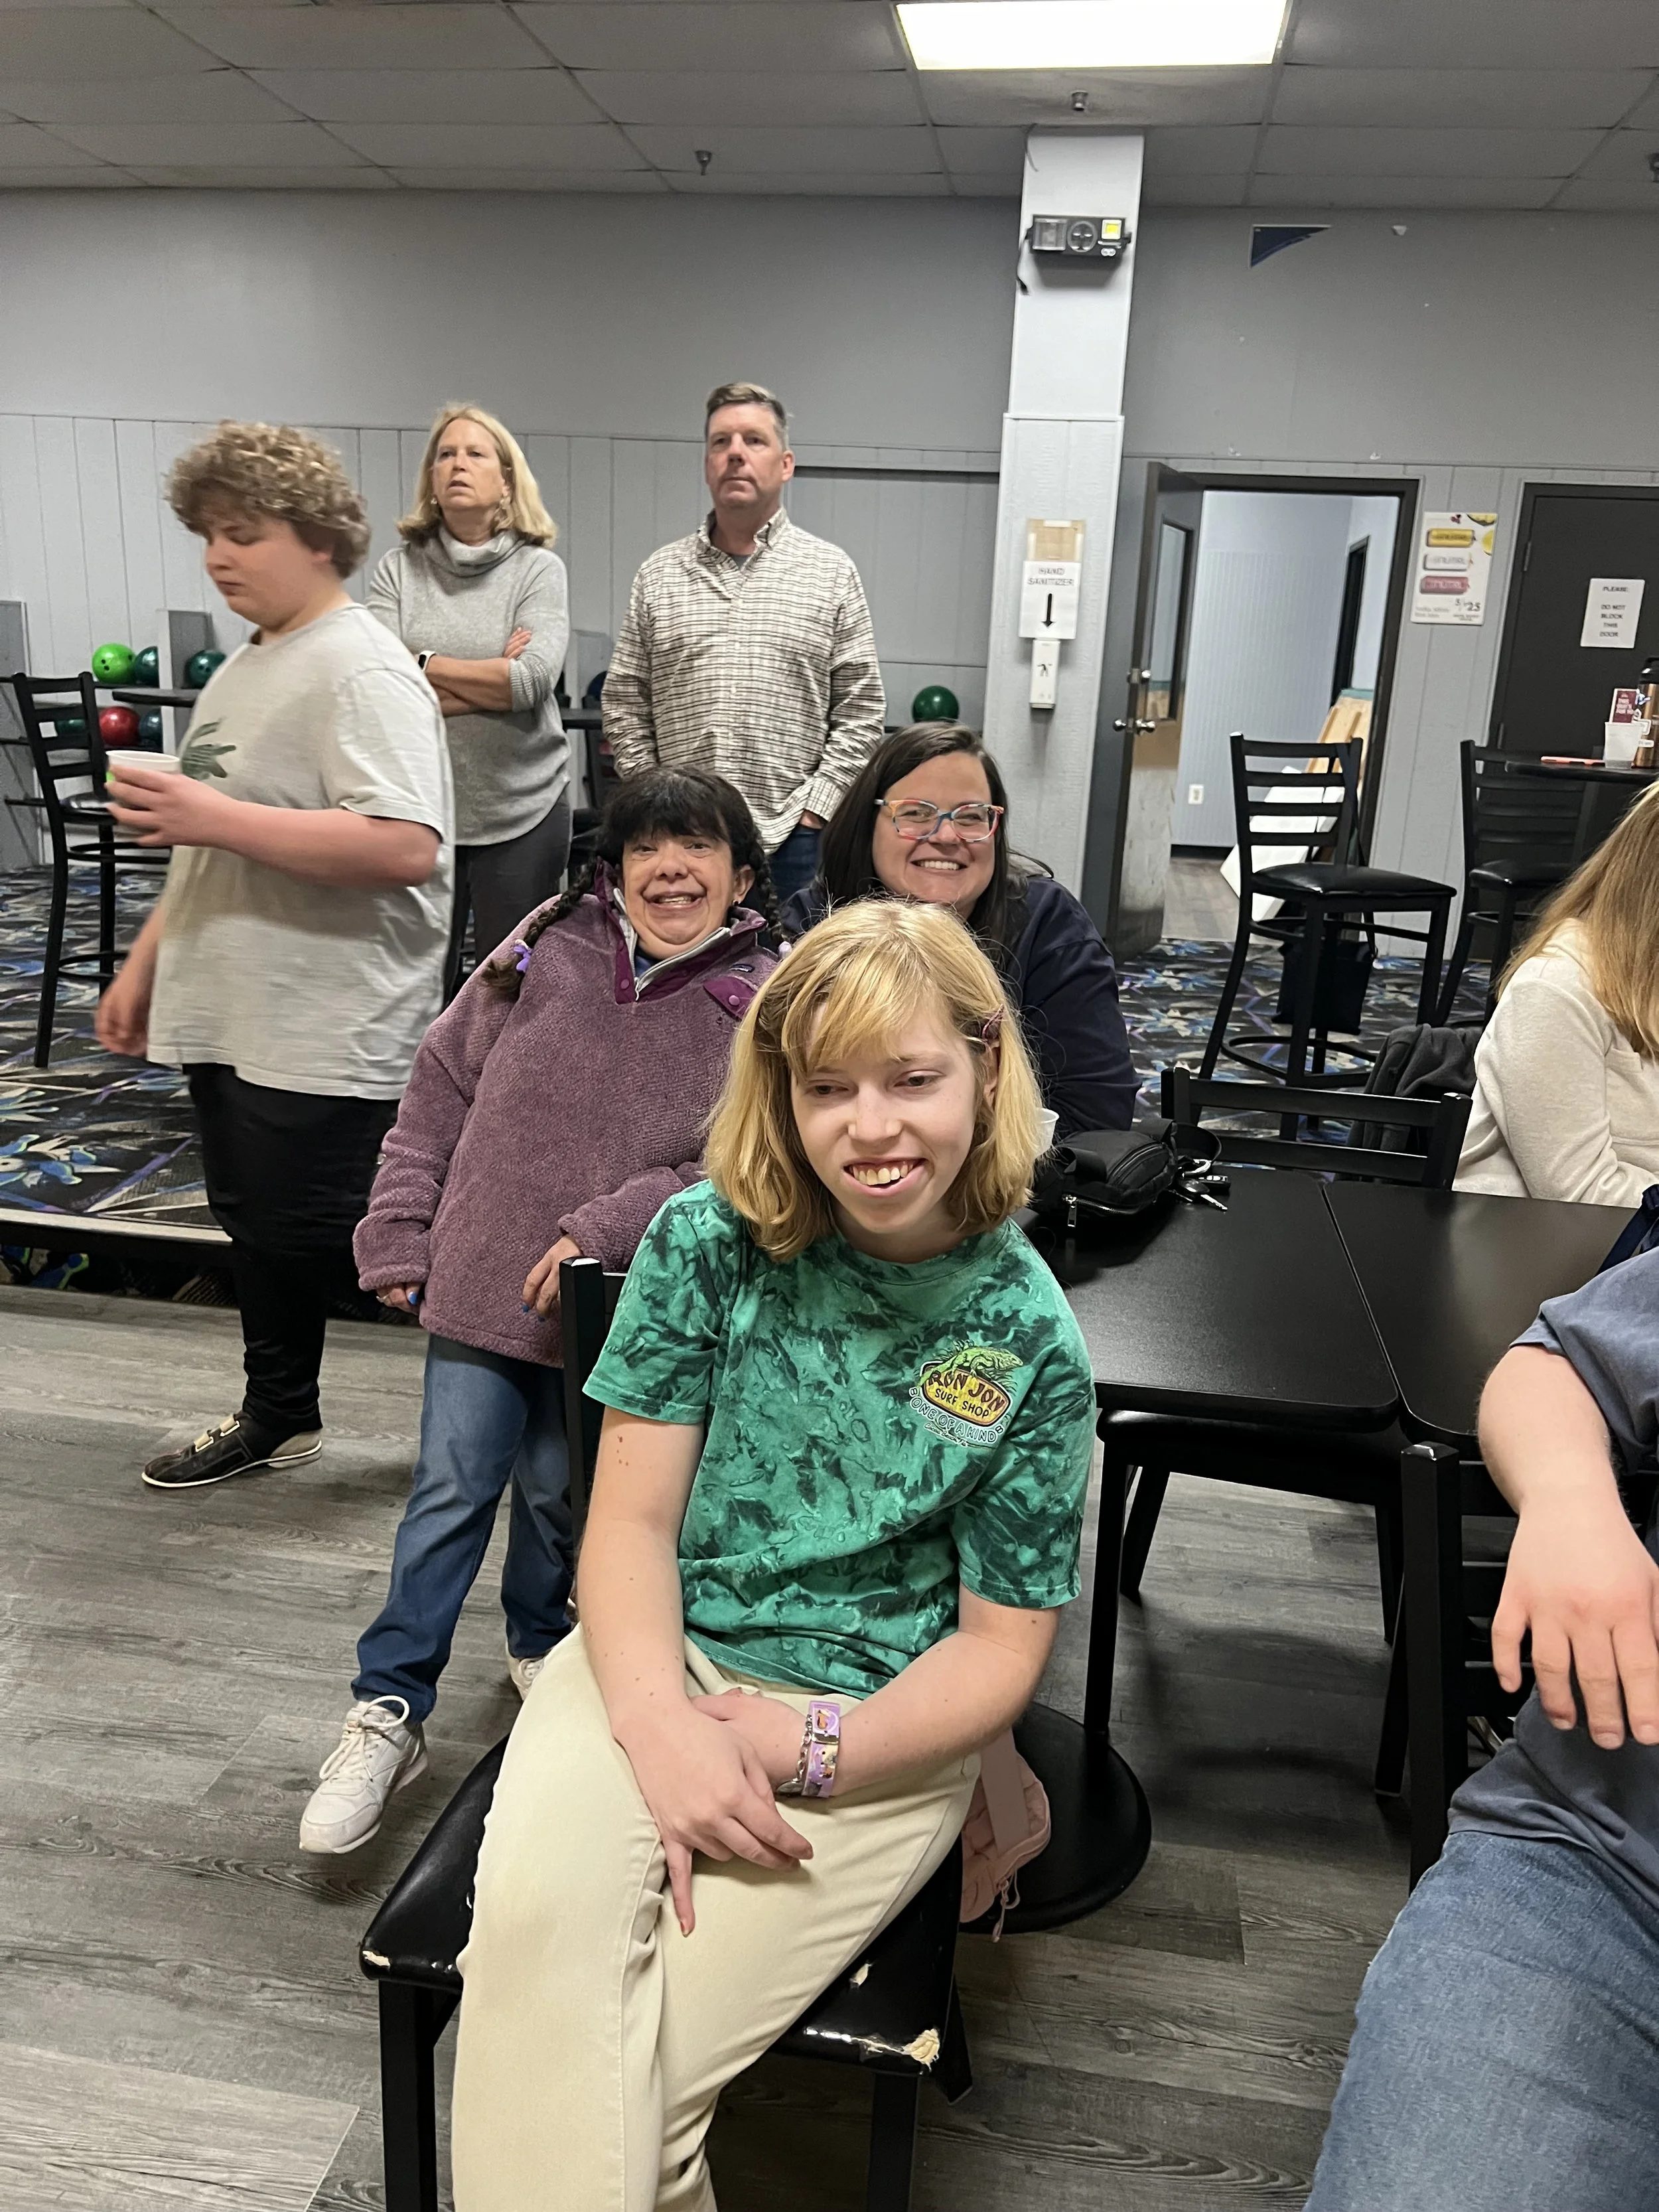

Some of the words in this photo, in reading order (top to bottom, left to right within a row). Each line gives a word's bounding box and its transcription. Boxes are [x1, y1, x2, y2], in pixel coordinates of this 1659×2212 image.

[929, 1370, 969, 1391] RON
[968, 1383, 1005, 1412] JON
[934, 1388, 958, 1406] SURF
[962, 1400, 989, 1419] SHOP
[938, 1414, 956, 1430] OF
[955, 1422, 965, 1436] A
